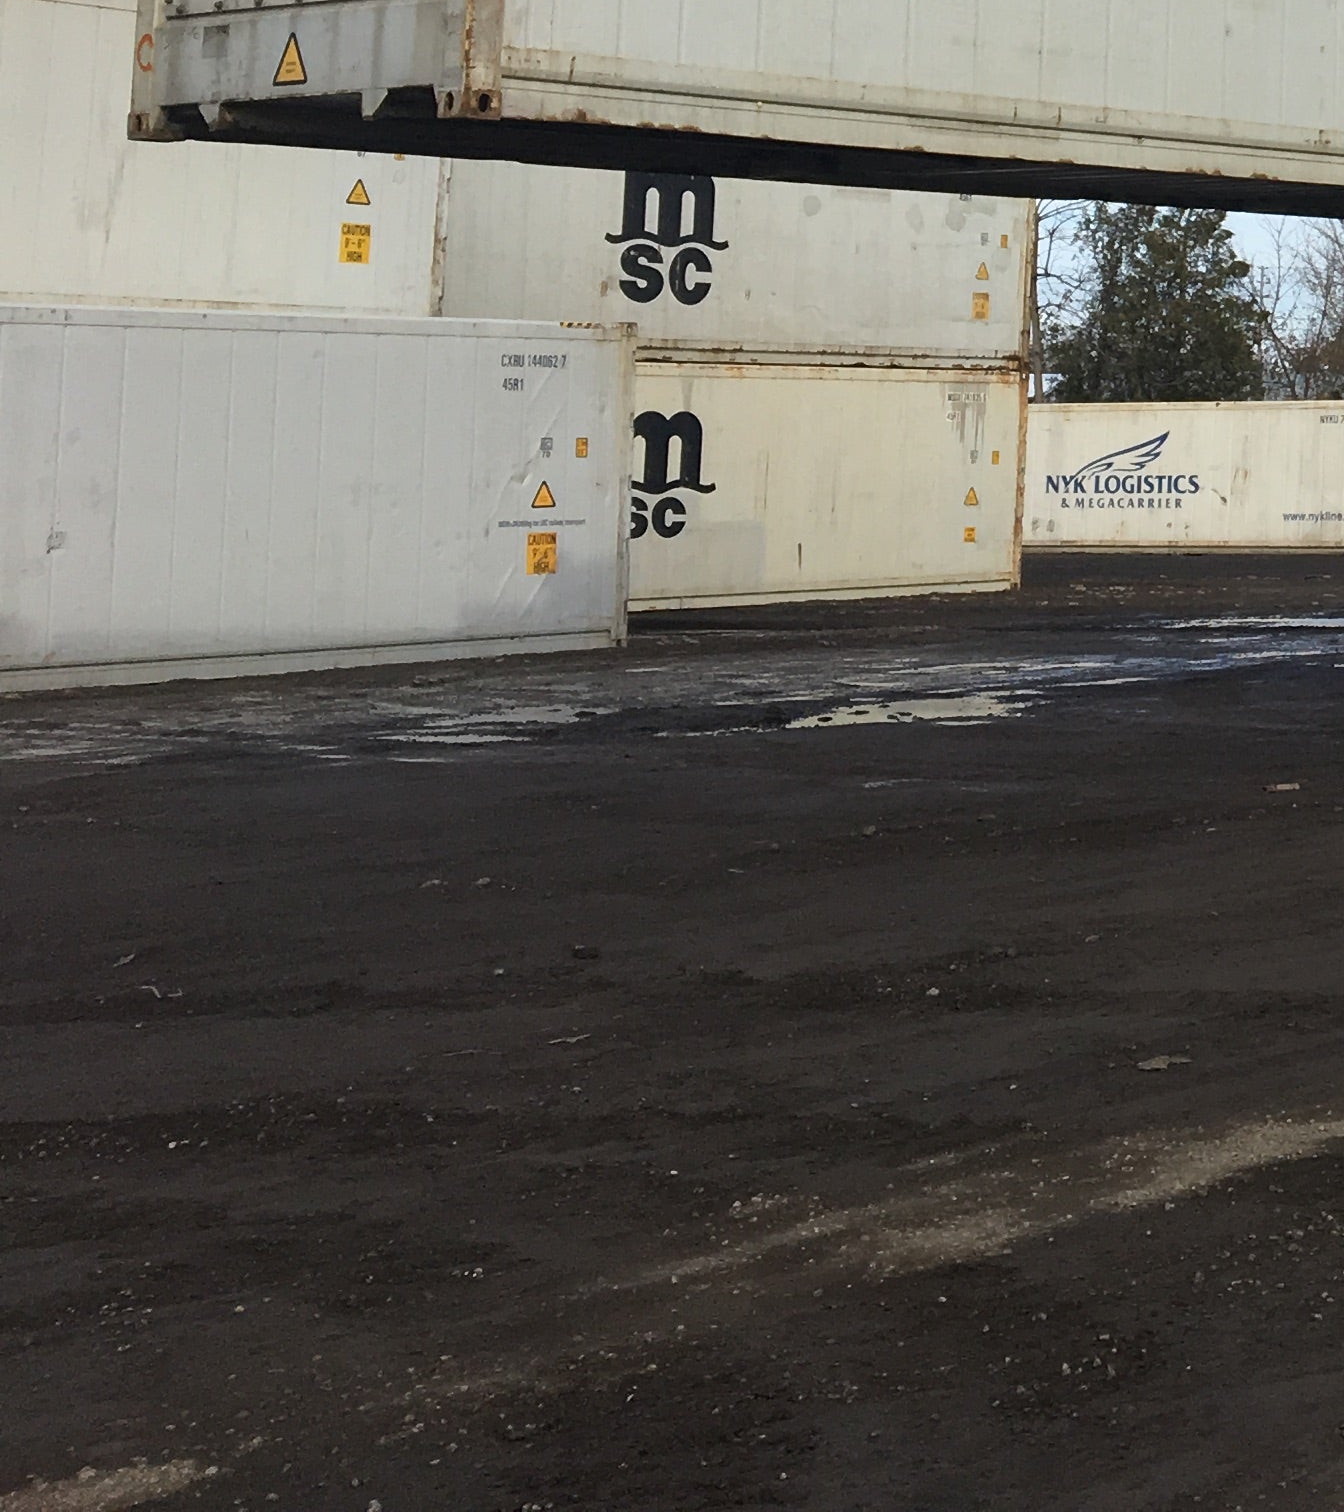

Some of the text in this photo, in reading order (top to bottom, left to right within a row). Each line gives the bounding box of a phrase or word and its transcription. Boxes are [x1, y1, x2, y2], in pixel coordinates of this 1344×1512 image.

[342, 223, 370, 236] CAUTION
[1045, 474, 1200, 494] NYK LOGISTICS
[1061, 497, 1183, 509] & MEGACARRIER
[527, 533, 557, 546] CAUTION
